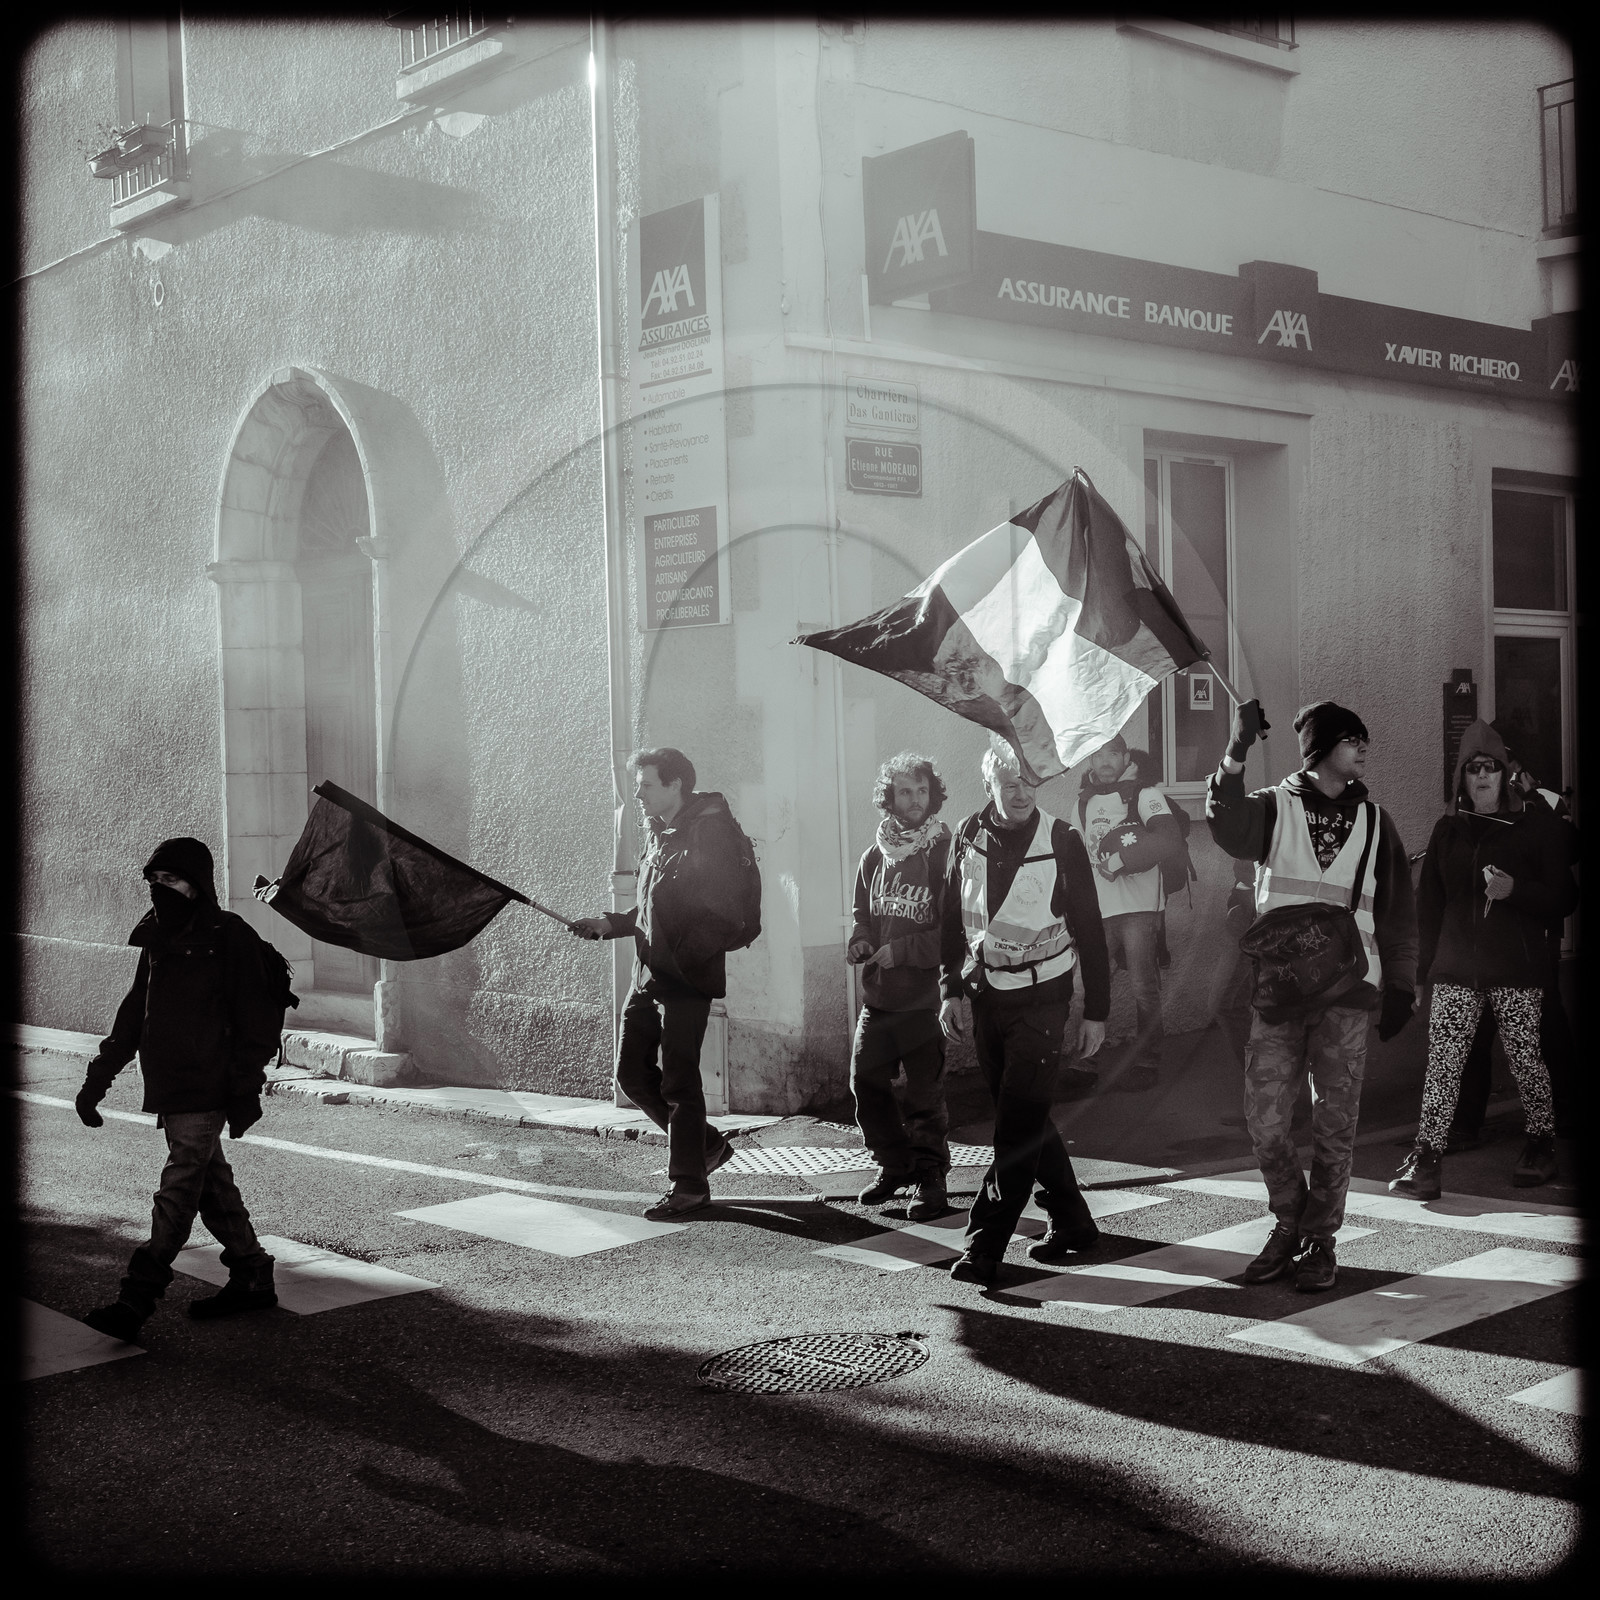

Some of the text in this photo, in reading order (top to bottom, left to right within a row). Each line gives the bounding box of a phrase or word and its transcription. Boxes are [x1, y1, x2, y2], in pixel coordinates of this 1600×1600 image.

[882, 208, 948, 274] AXA
[641, 264, 695, 319] AXA
[997, 277, 1234, 335] ASSURANCE BANQUE
[639, 316, 710, 346] ASSURANCES
[1257, 309, 1313, 351] AXA
[1385, 342, 1521, 380] XAVIER RICHIERO
[648, 388, 685, 404] Automobile
[849, 403, 867, 418] Das
[649, 423, 682, 437] Habitation
[650, 453, 689, 469] Placements
[875, 446, 893, 458] RUE
[851, 458, 918, 477] Etienne MOREAUD
[650, 473, 675, 485] Retraite
[653, 514, 700, 532] PARTICULIERS
[654, 533, 698, 550] ENTREPRISES
[654, 550, 706, 568] AGRICULTEURS
[655, 570, 688, 585] ARTISANS
